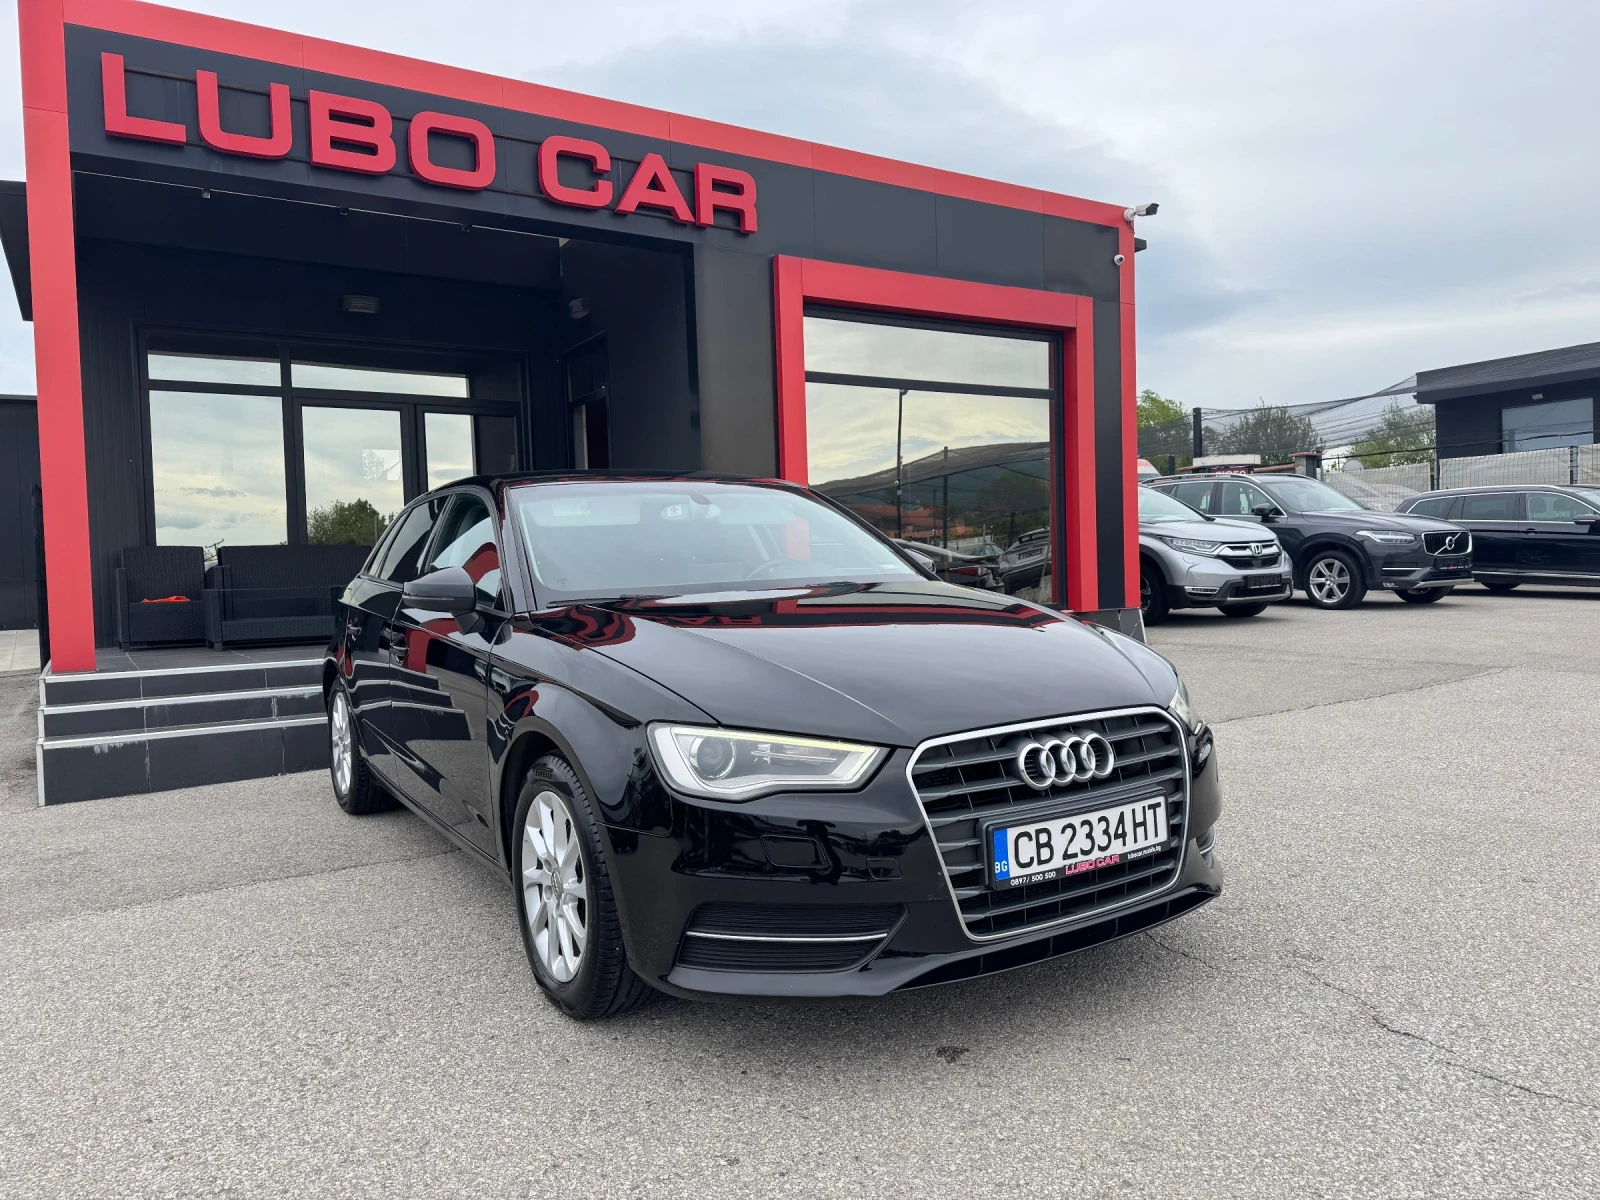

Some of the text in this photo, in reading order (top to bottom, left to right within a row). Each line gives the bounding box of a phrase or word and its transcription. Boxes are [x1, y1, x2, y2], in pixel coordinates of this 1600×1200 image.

[101, 52, 758, 234] LUBO CAR
[1013, 801, 1162, 870] CB 2334 HT
[994, 861, 1008, 874] BG
[1065, 853, 1120, 875] LUBO CAR
[1031, 873, 1044, 882] 500
[1044, 871, 1056, 880] 500
